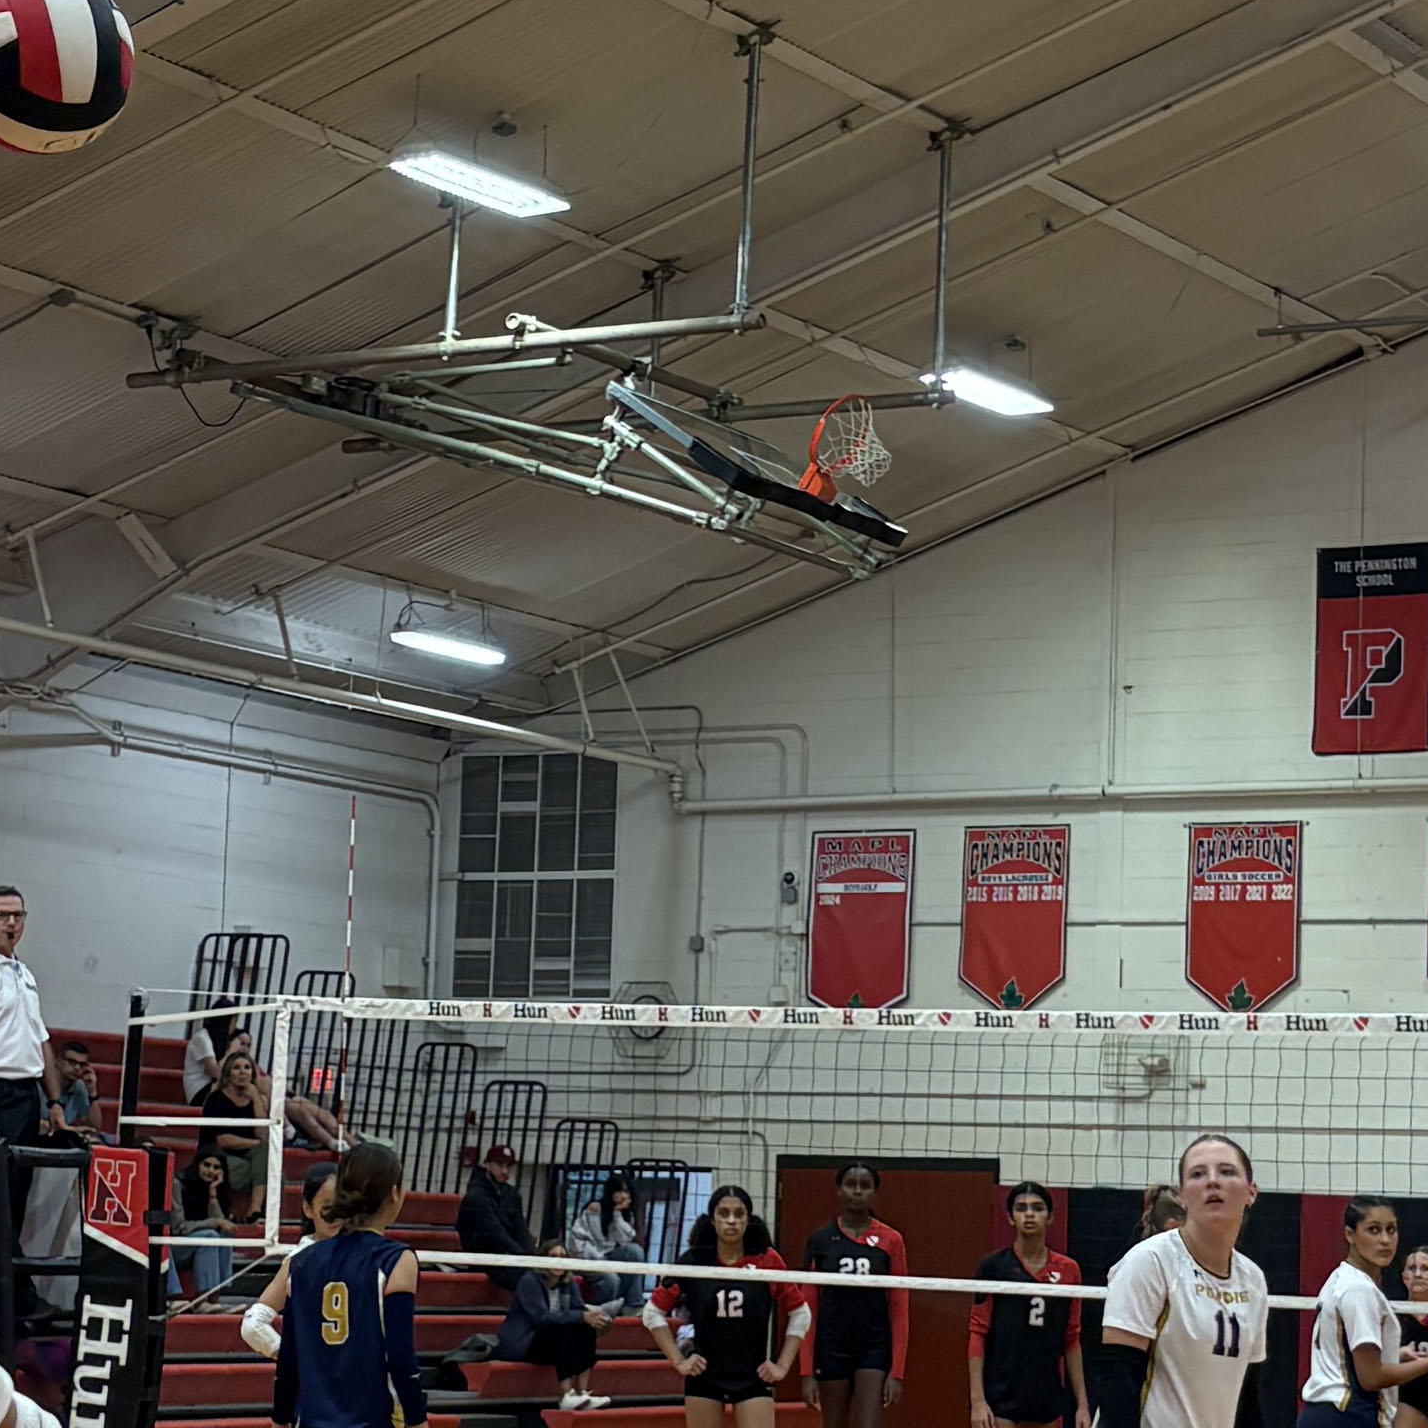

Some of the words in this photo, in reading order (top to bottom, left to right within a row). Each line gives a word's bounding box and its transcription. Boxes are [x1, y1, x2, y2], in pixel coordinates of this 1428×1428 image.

[1334, 561, 1352, 573] THE
[1354, 557, 1417, 572] PENNINGTON
[1356, 574, 1394, 586] SCHOOL
[1341, 628, 1404, 719] P
[825, 838, 901, 852] MAPL
[969, 840, 1063, 879] CHAMPIONS
[1194, 836, 1294, 877] CHAMPIONS
[1206, 873, 1238, 881] GIRLS
[428, 1001, 462, 1018] Hun
[482, 1003, 493, 1018] H
[513, 1002, 548, 1018] Hun
[600, 1005, 636, 1021] Hun
[658, 1007, 669, 1022] H
[690, 1007, 727, 1023] Hun
[783, 1009, 819, 1025] Hun
[842, 1010, 854, 1025] H
[876, 1010, 915, 1026] Hun
[974, 1012, 1014, 1028] Hun
[1038, 1013, 1050, 1028] H
[1075, 1012, 1116, 1029] Hun
[1178, 1013, 1220, 1030] Hun
[1246, 1014, 1258, 1031] H
[1285, 1014, 1329, 1031] Hun
[88, 1158, 137, 1227] H
[321, 1281, 350, 1346] 9
[716, 1289, 744, 1318] 12
[1029, 1297, 1046, 1326] 2
[1212, 1309, 1240, 1358] 11
